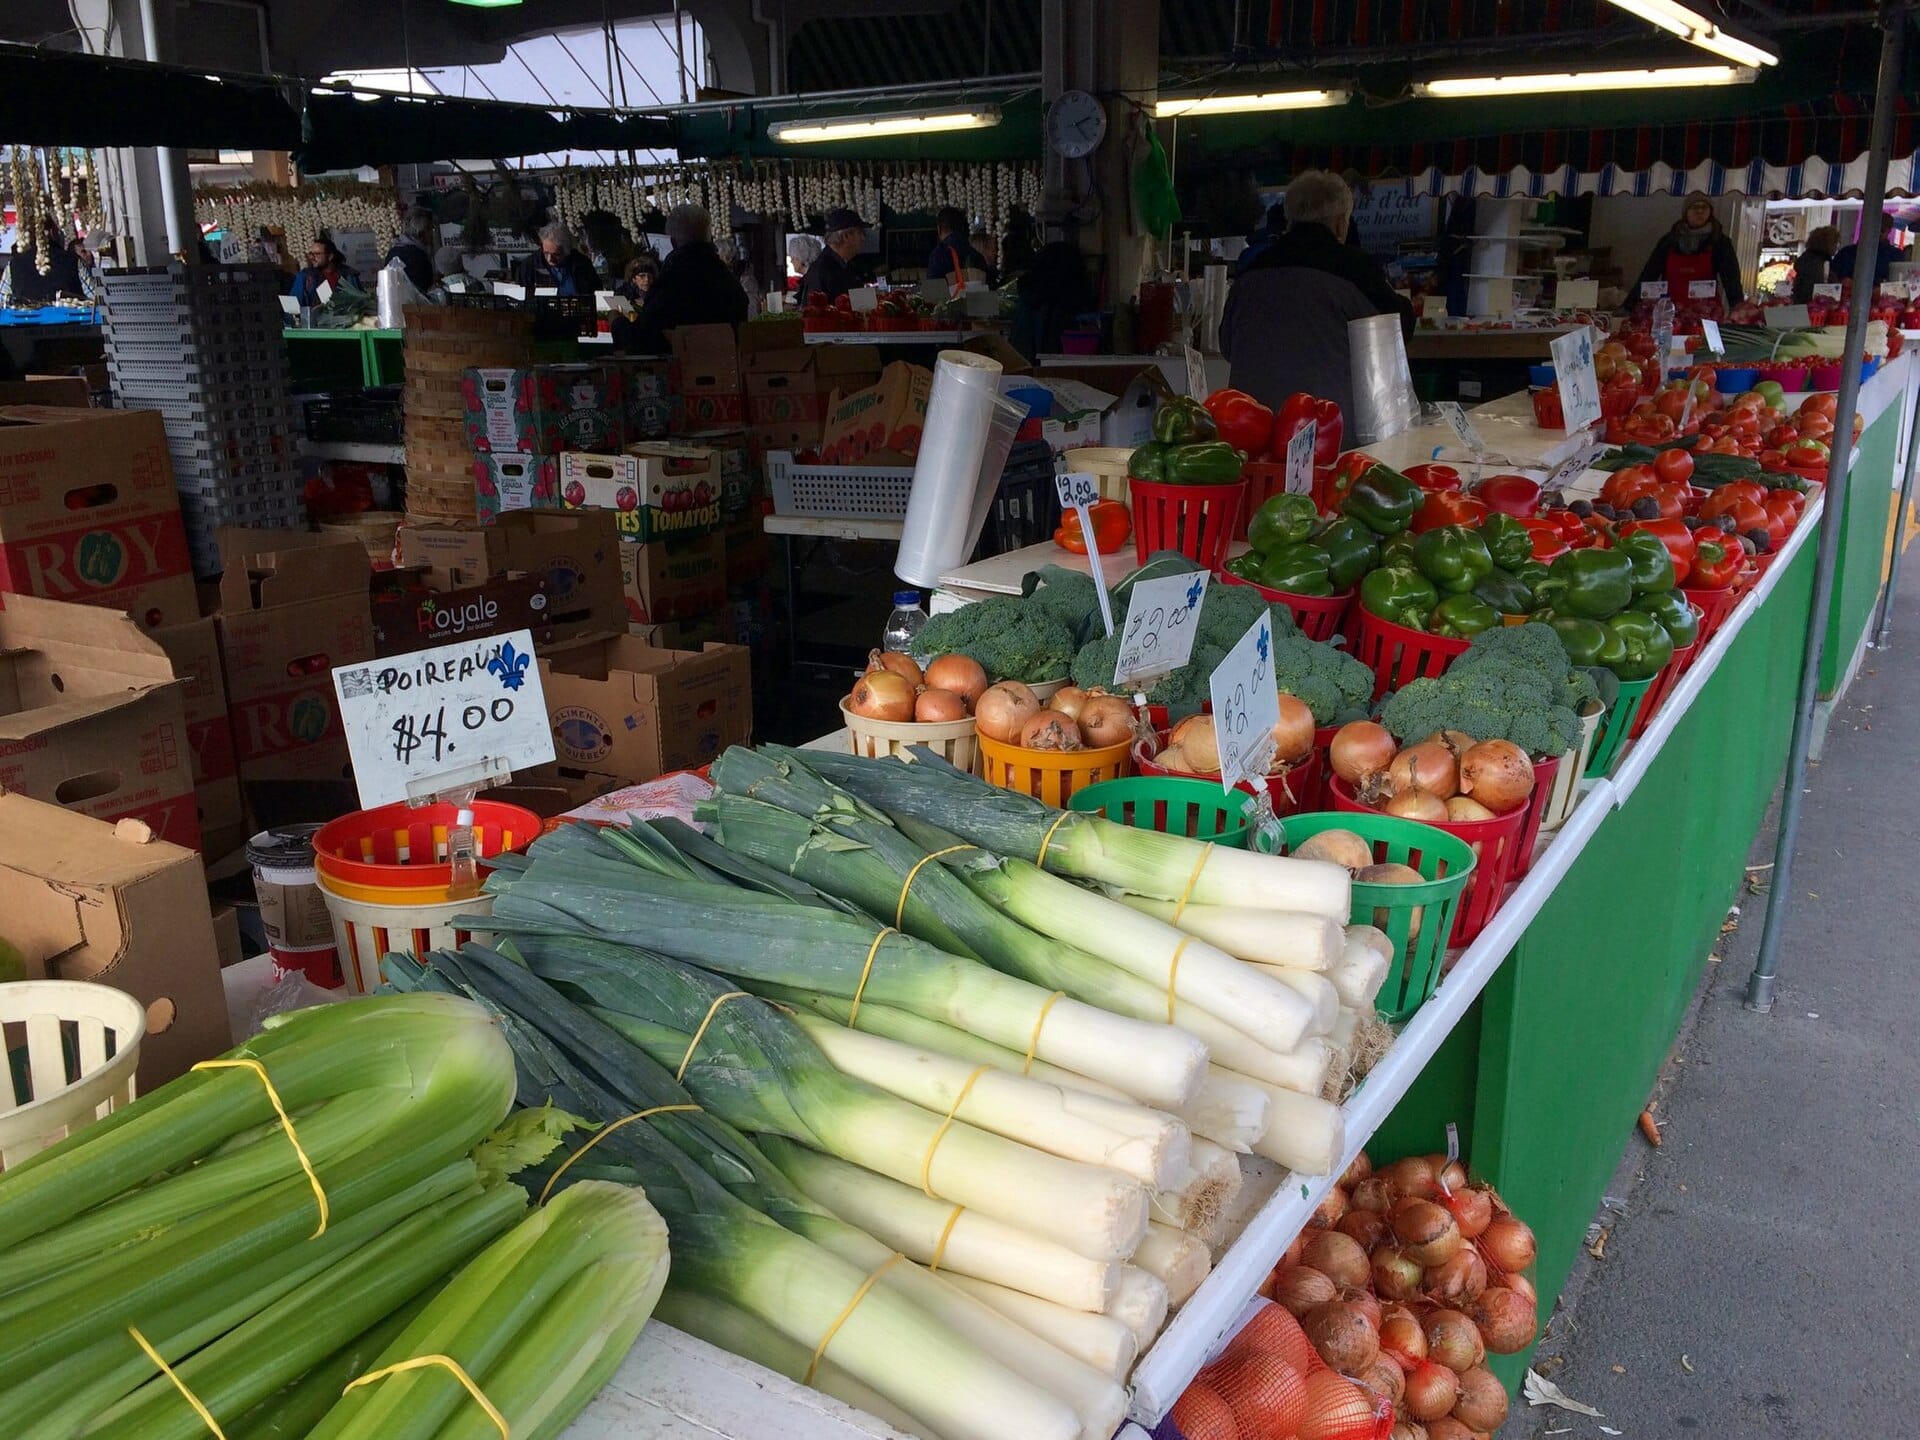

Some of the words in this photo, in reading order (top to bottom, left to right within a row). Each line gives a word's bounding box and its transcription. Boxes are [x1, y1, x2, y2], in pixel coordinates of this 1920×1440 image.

[651, 502, 720, 533] TOMATOES
[16, 519, 167, 598] ROY
[416, 594, 499, 634] Royale
[377, 643, 501, 695] POIREAUX
[392, 698, 515, 765] $4.00
[554, 709, 604, 732] ALIMENTS
